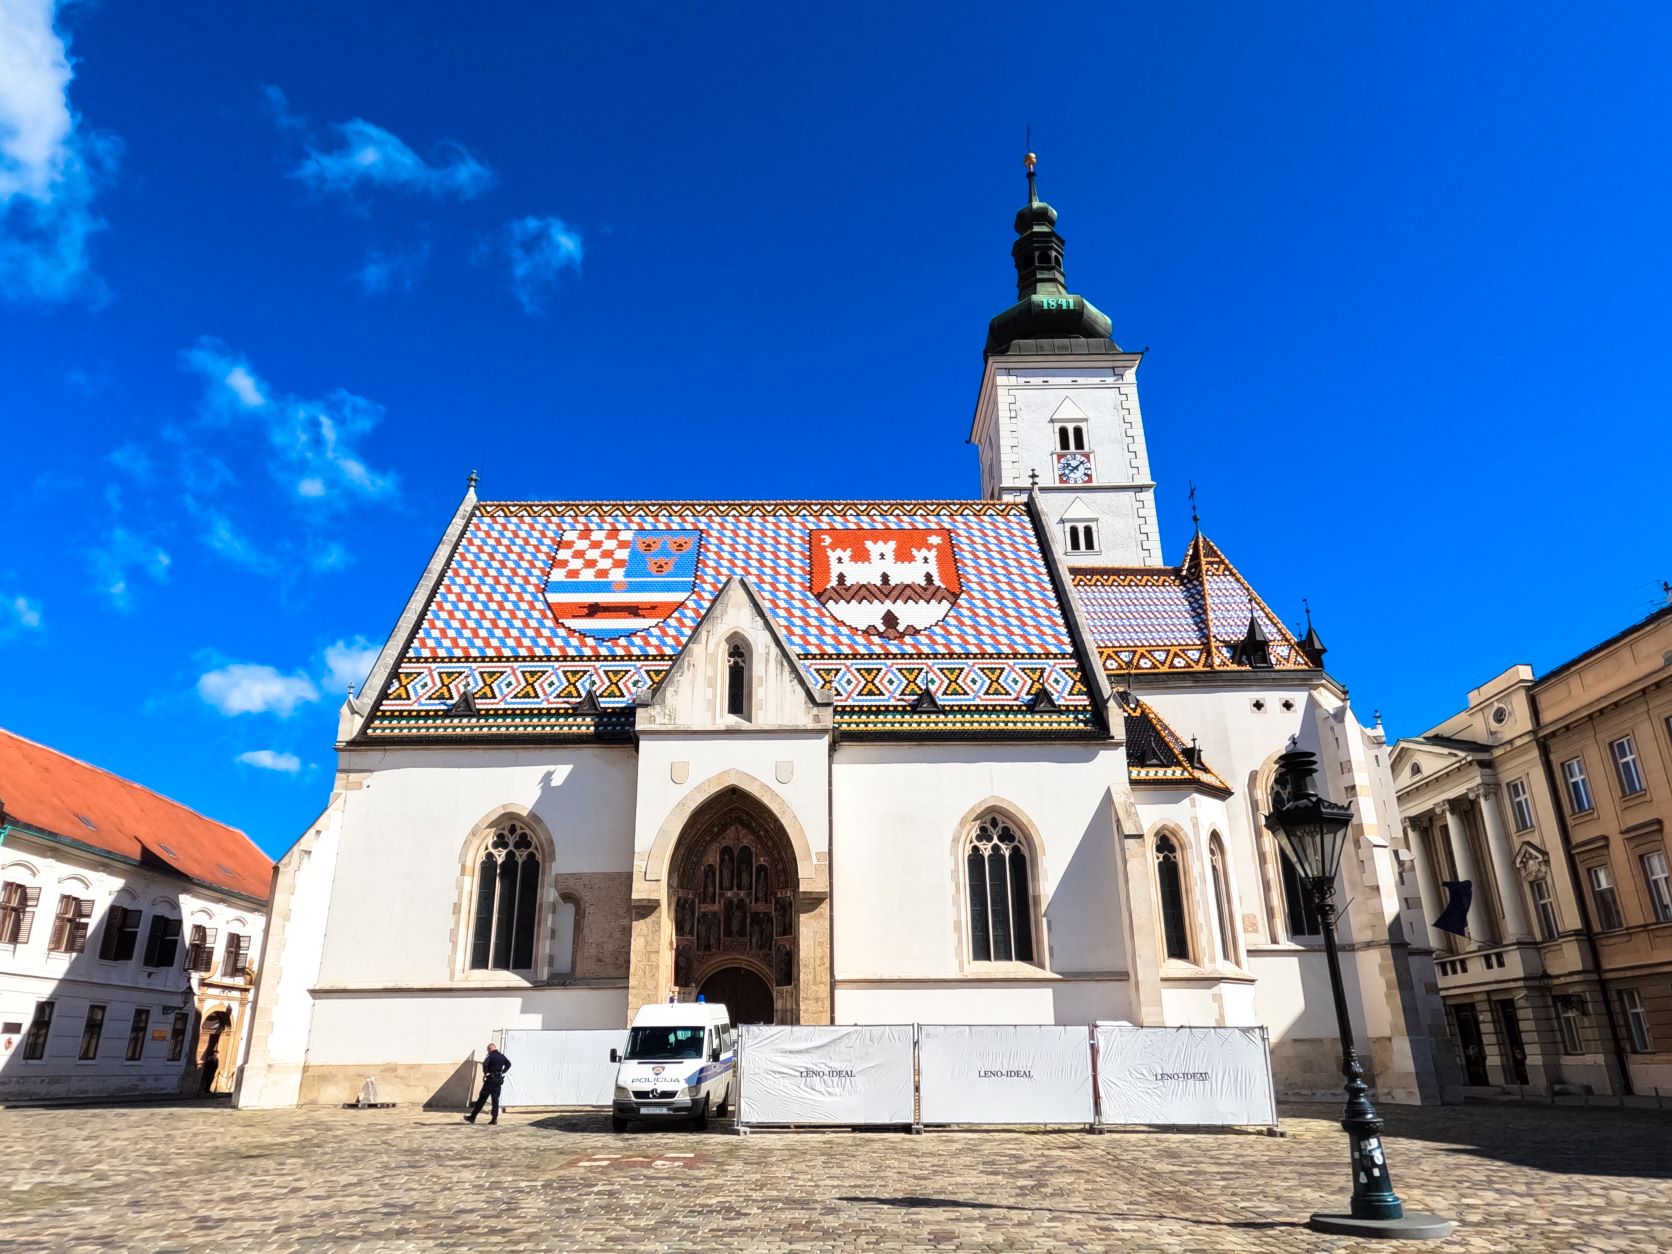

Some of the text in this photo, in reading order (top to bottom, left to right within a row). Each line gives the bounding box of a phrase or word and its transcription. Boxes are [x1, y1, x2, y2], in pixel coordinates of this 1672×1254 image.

[1042, 298, 1075, 310] 1841
[799, 1070, 856, 1078] LENO-IDEAL
[978, 1070, 1034, 1078] LENO-IDEAL
[631, 1076, 681, 1084] POLICIJA
